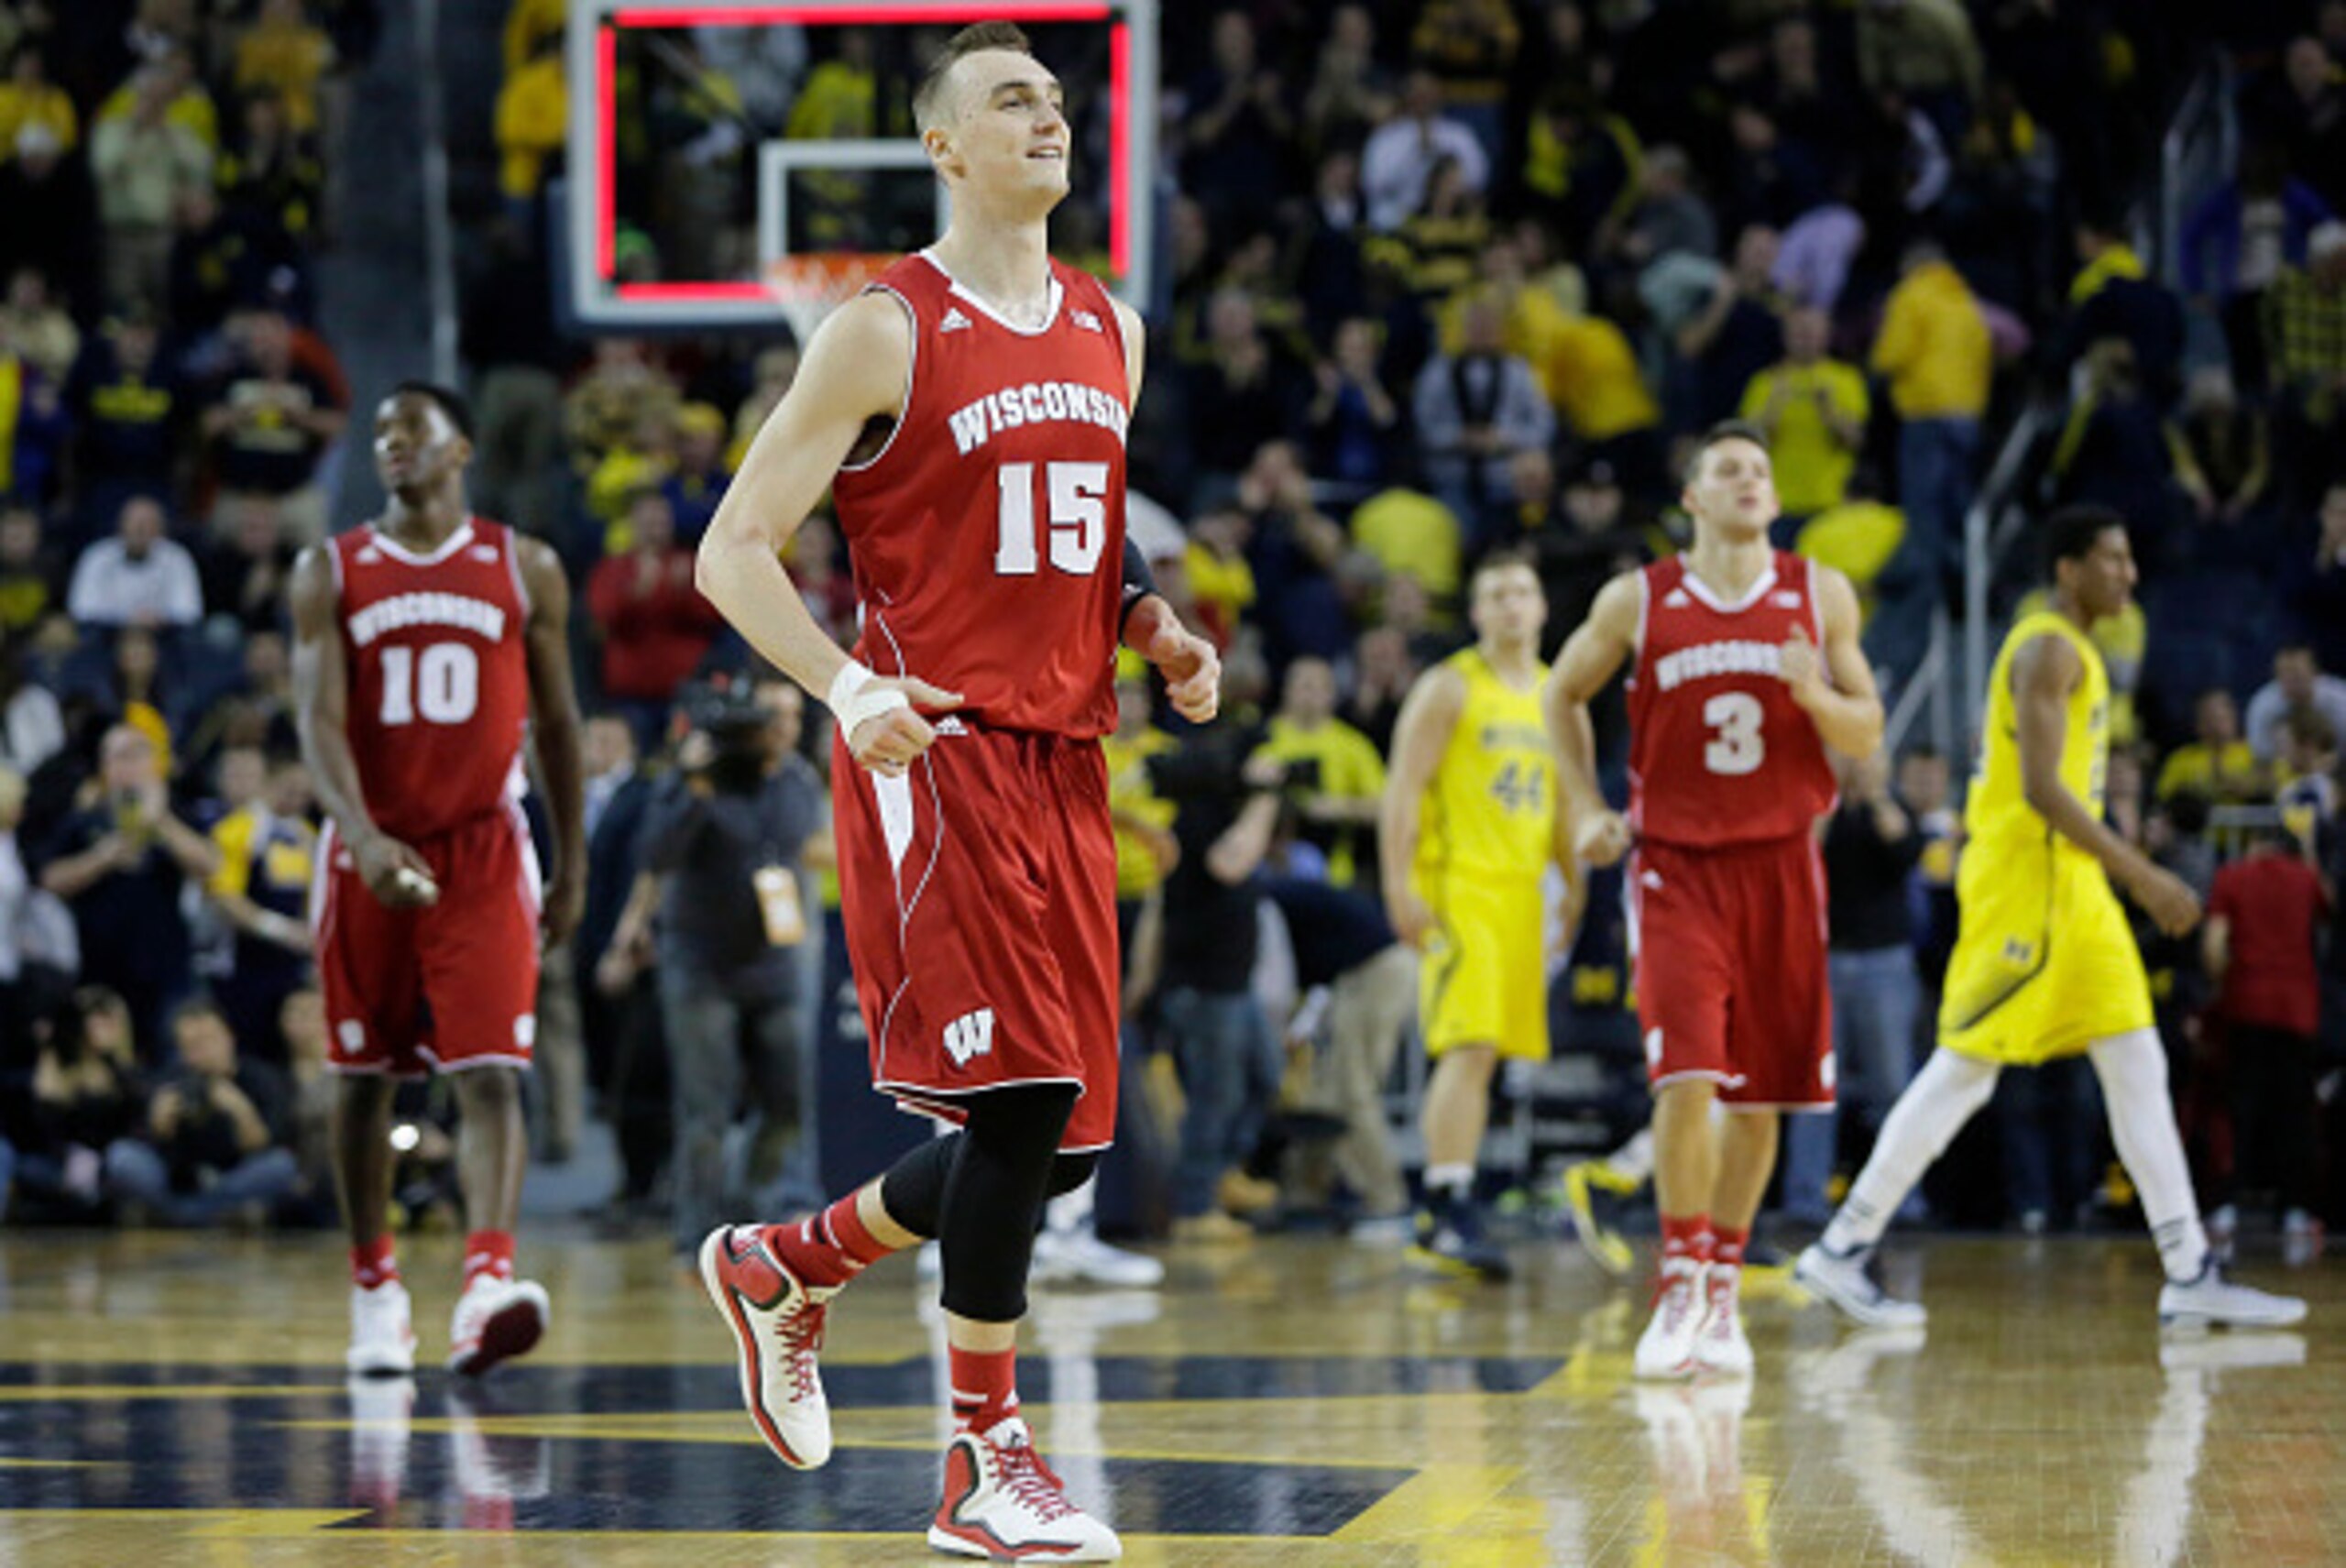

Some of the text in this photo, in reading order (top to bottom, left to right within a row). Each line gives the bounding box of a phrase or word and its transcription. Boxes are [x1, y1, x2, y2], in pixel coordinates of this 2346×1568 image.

[995, 461, 1110, 575] 15
[347, 591, 505, 648] WISCONSIN
[379, 641, 479, 726] 10
[1655, 639, 1780, 692] WISCONS
[1704, 691, 1765, 775] 3
[943, 1006, 995, 1069] W
